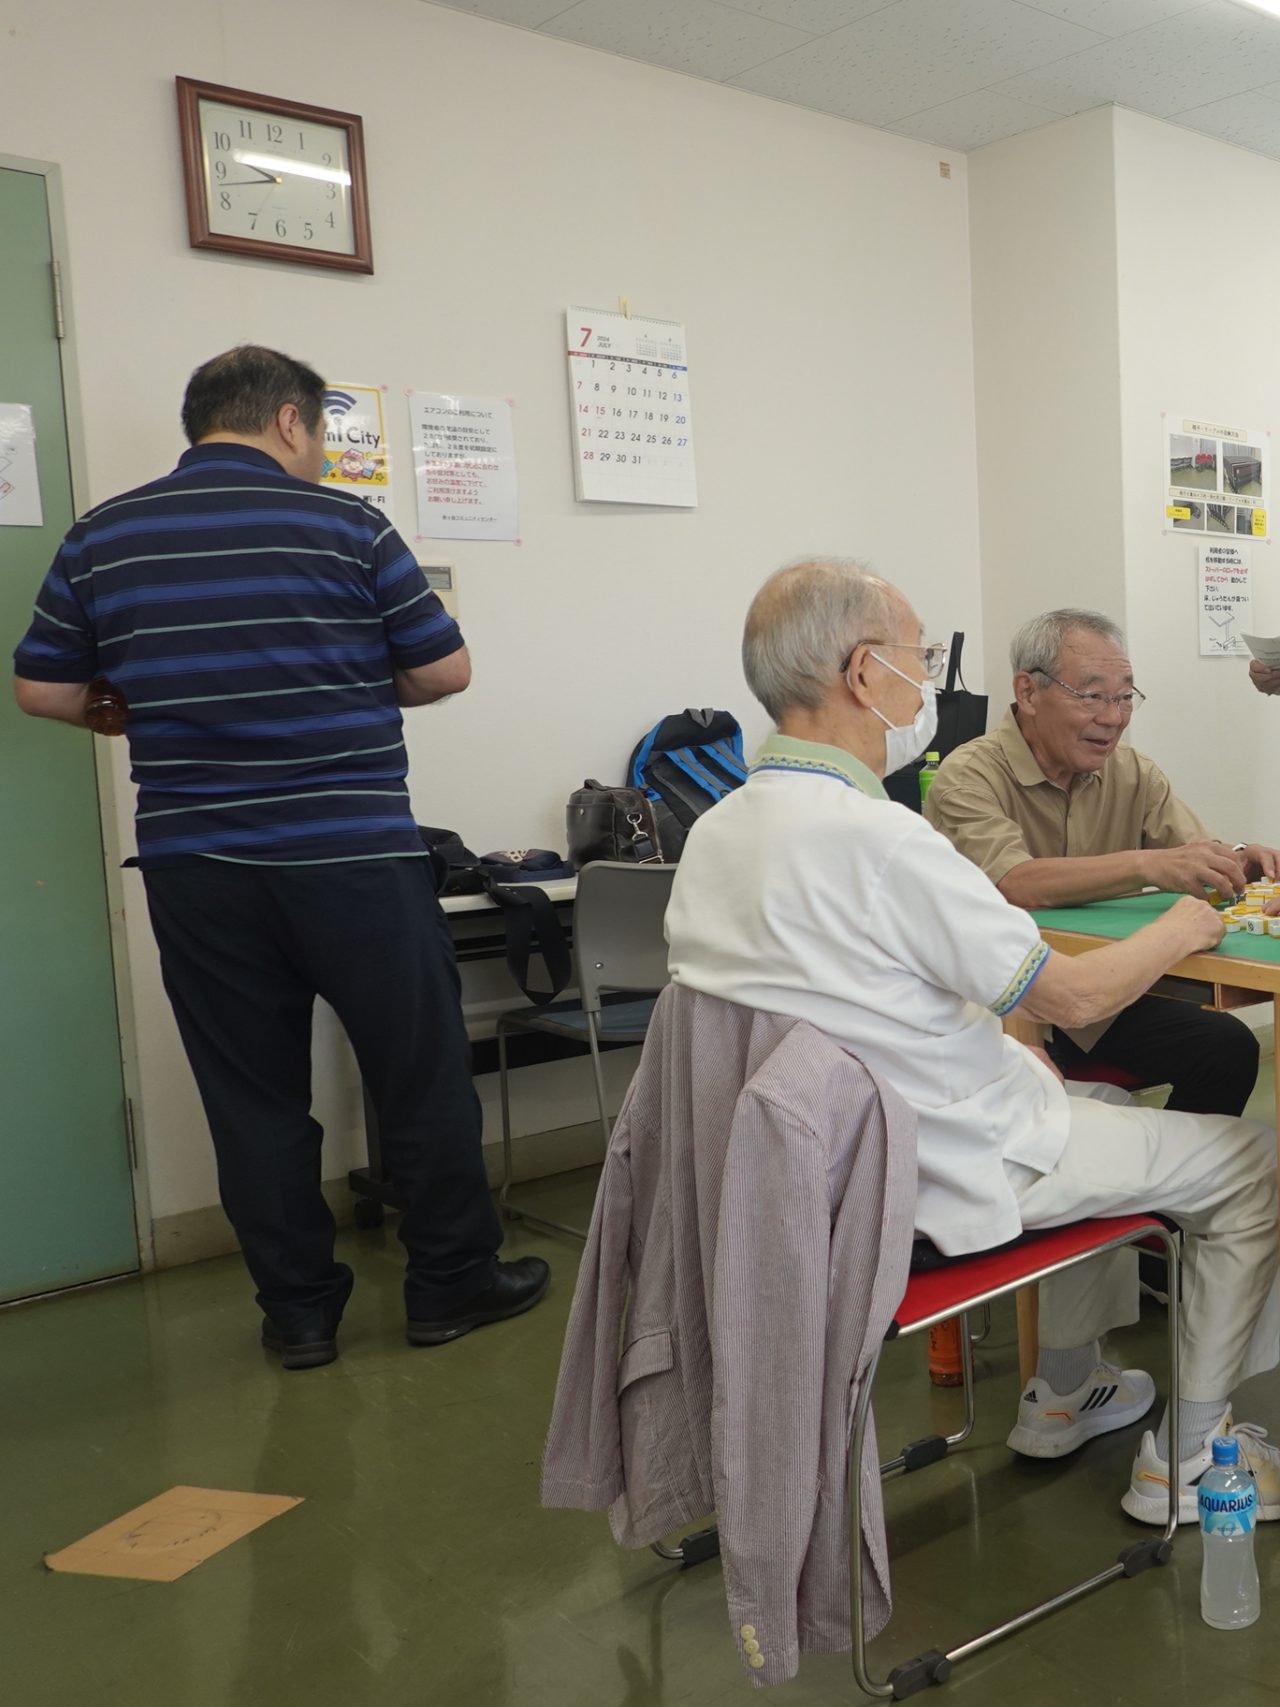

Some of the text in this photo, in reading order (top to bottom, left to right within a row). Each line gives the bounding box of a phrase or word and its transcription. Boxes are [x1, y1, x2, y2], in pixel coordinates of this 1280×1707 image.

[238, 120, 253, 139] 11
[266, 123, 283, 143] 12
[214, 131, 231, 151] 10
[297, 132, 305, 150] 1
[215, 160, 227, 180] 9
[220, 192, 232, 211] 8
[326, 184, 336, 200] 3
[248, 212, 258, 230] 7
[275, 220, 287, 238] 6
[325, 211, 335, 228] 4
[304, 222, 314, 240] 5
[580, 327, 592, 347] 7
[591, 360, 677, 379] 1 2 3 4 5 6
[577, 381, 682, 402] 7 8 9 10 11 12 13
[578, 404, 686, 424] 14 15 16 17 18 19 20
[347, 426, 380, 448] City
[581, 428, 688, 446] 21 22 23 24 25 26 27
[584, 451, 641, 464] 28 29 30 31
[1200, 1494, 1253, 1512] AQUARIUS
